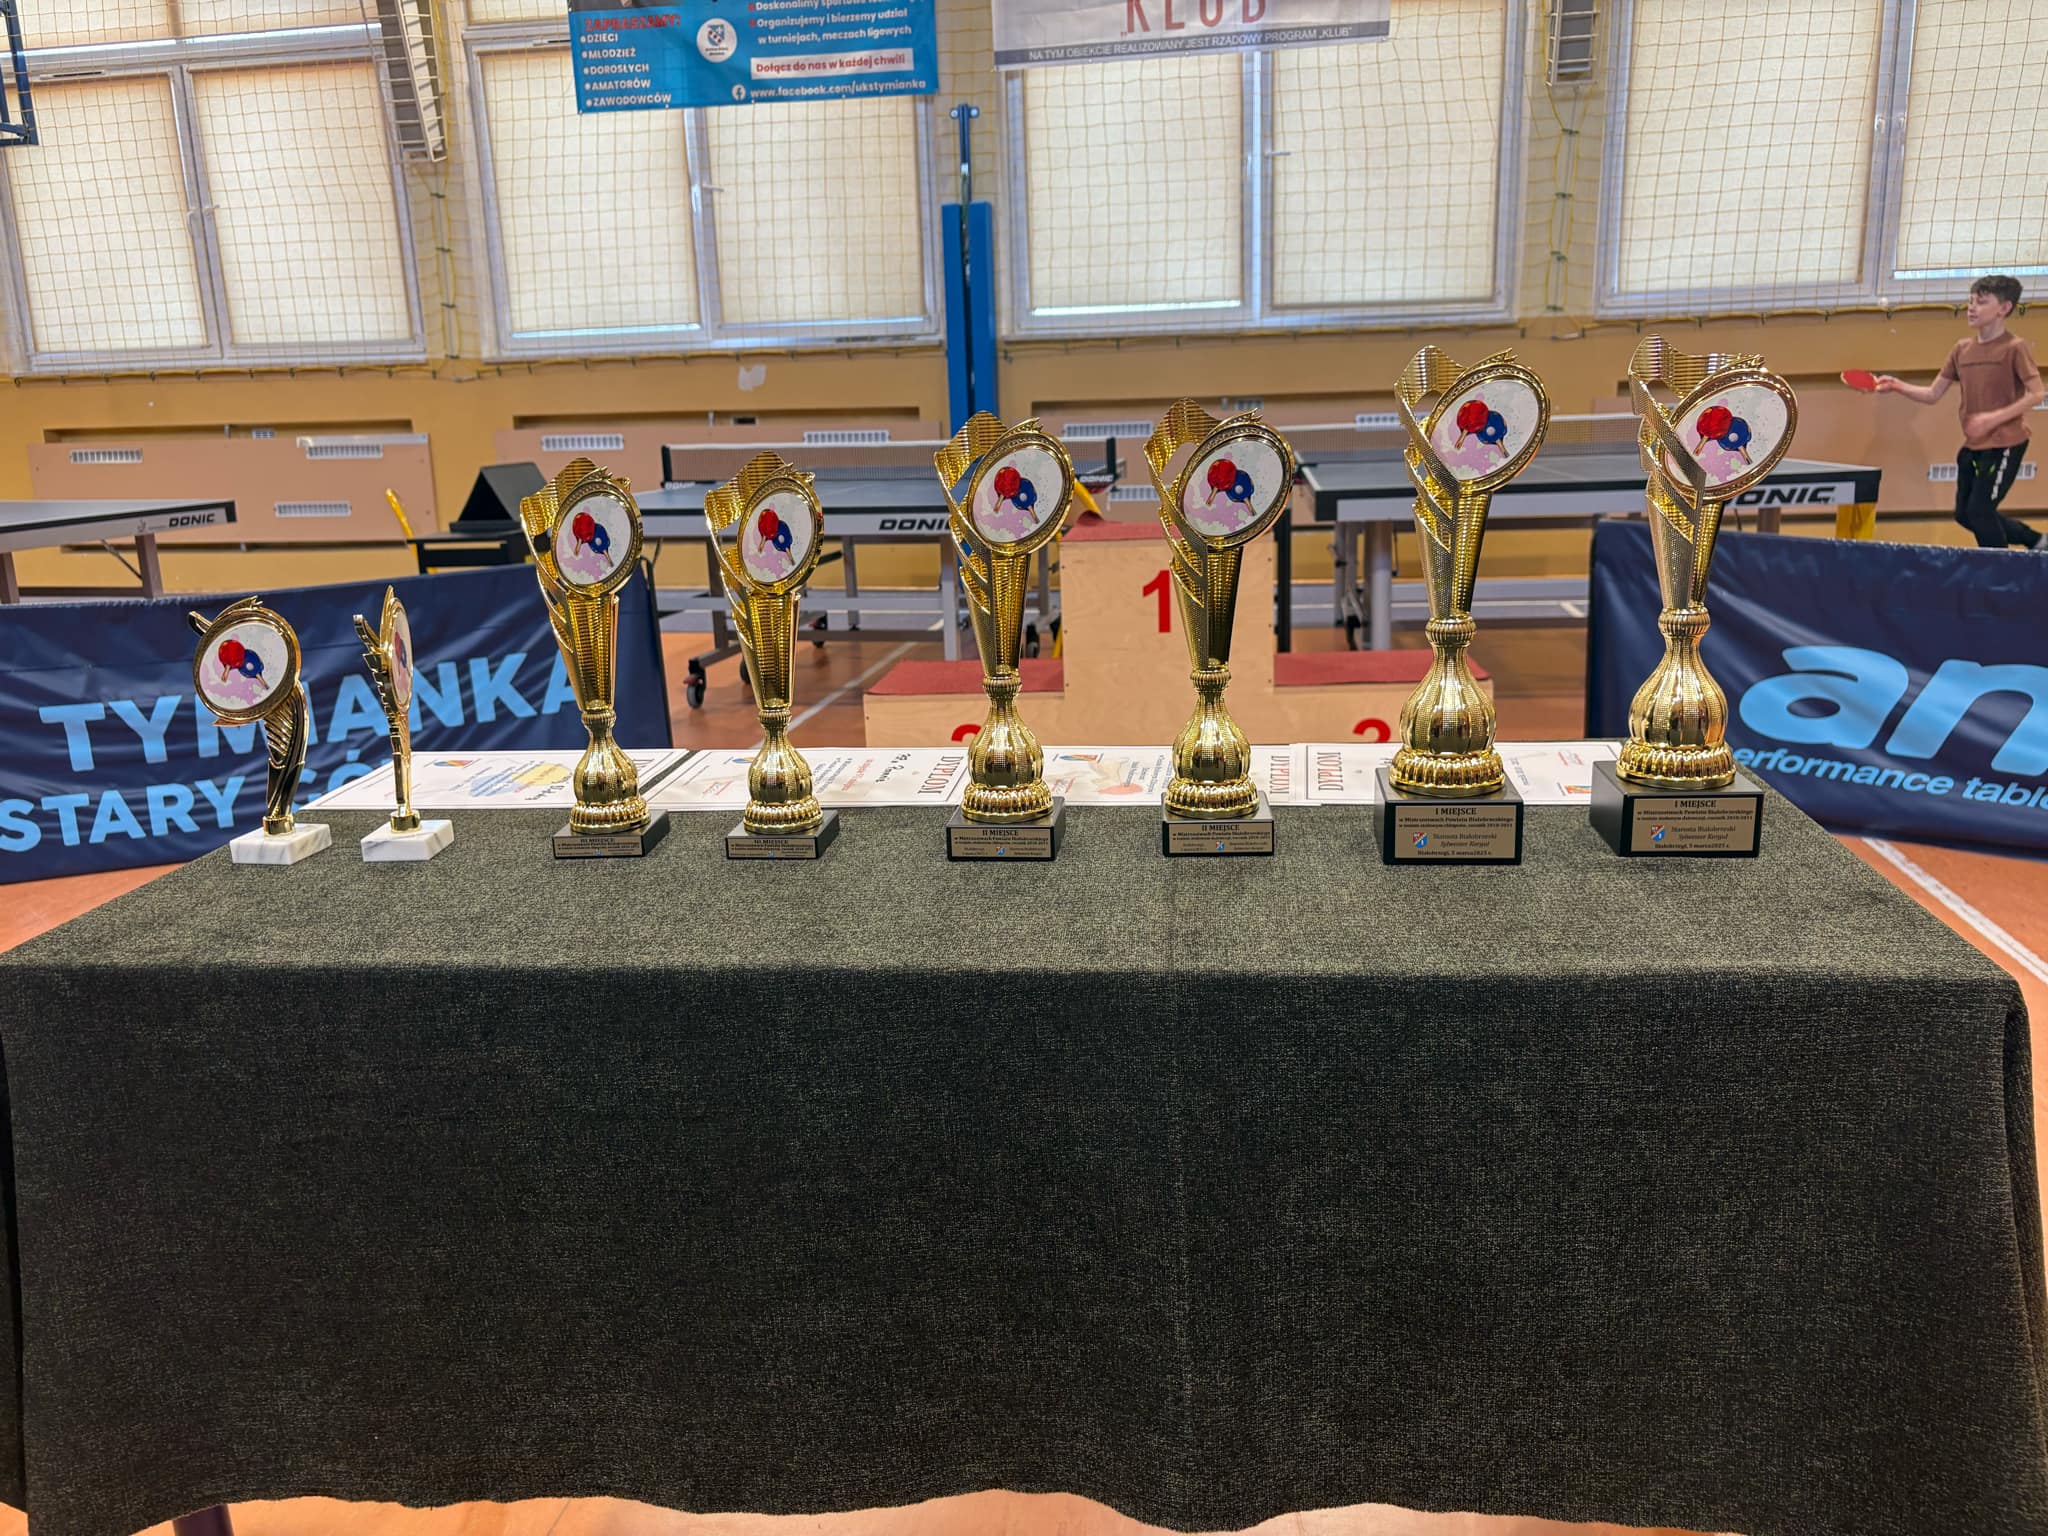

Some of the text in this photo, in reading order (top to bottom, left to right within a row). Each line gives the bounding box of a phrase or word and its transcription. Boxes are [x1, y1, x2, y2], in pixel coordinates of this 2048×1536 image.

[757, 16, 825, 30] Organizujemy
[831, 12, 876, 23] bierzemy
[587, 33, 618, 43] DZIECI
[758, 25, 912, 46] w turniejach, meczach ligowych
[1029, 50, 1043, 60] NA
[1044, 49, 1065, 60] TYM
[1066, 46, 1113, 58] OBIEKCIE
[1114, 40, 1184, 54] REALIZOWANY
[1185, 37, 1210, 48] JEST
[1265, 29, 1317, 42] PROGRAM
[590, 63, 649, 75] DOROSŁYCH
[756, 53, 905, 74] Dołącz do nas w każdej chwili
[592, 77, 651, 90] AMATORÓW
[751, 80, 926, 98] www.facebook.com/ukstymianka
[593, 92, 671, 106] ZAWODOWCÓW
[1723, 485, 1836, 505] ONIC
[169, 513, 215, 528] DONIC
[879, 519, 951, 531] DONI
[1143, 569, 1171, 633] 1
[917, 756, 964, 794] DYPLOM
[1317, 752, 1344, 792] DYPLOM
[1733, 748, 1954, 795] erformance
[1440, 808, 1477, 816] MIEJSCE
[1680, 800, 1717, 808] MIEJSCE
[0, 776, 245, 853] STARY
[1209, 824, 1240, 832] MIEJSCE
